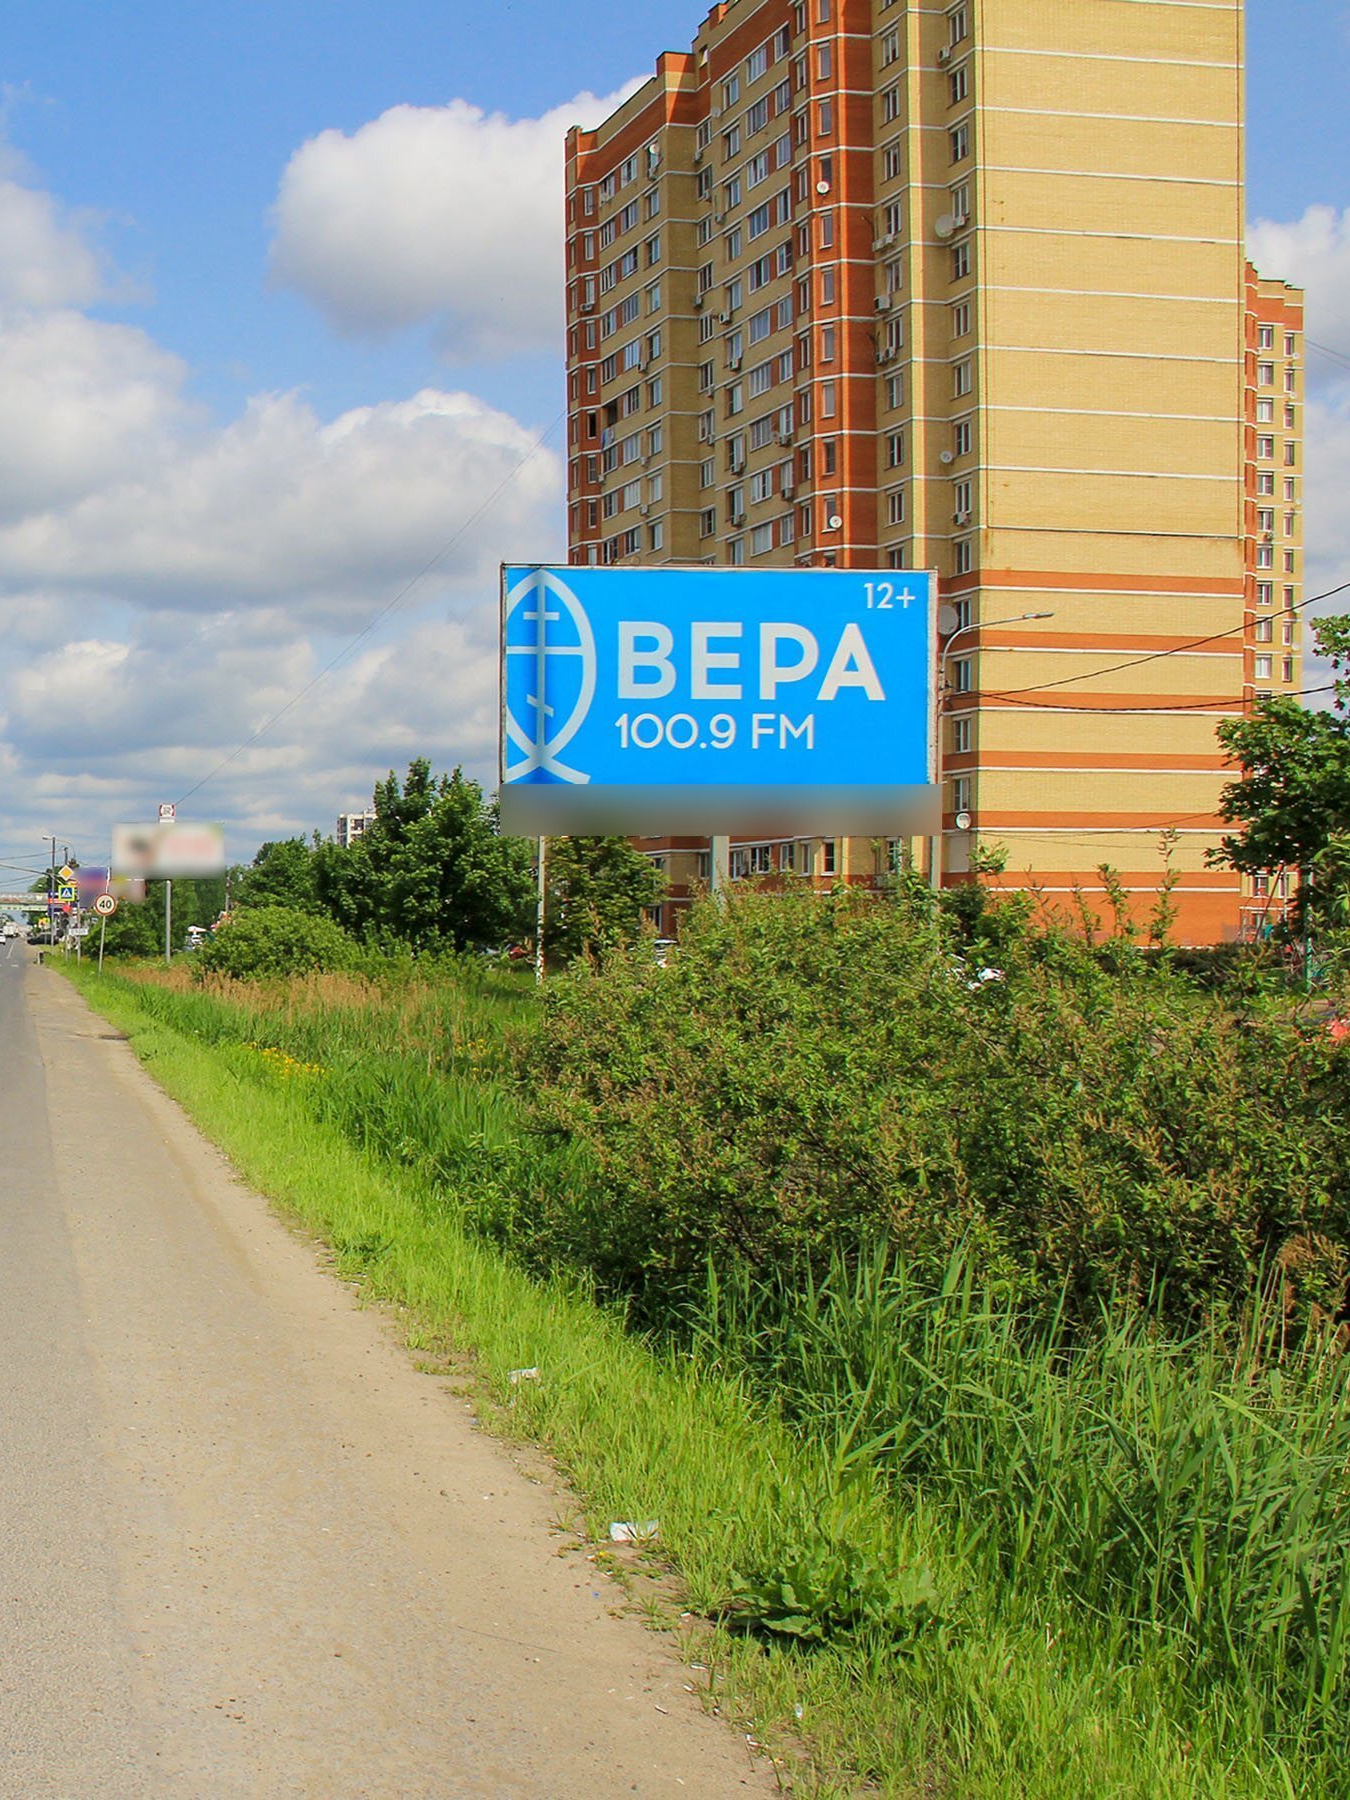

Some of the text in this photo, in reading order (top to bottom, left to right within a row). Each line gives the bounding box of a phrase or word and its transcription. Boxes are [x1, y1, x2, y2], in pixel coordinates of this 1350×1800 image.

[863, 583, 916, 609] 12+
[617, 621, 886, 701] ВЕРА
[615, 713, 815, 750] 100.9 FM
[99, 900, 112, 909] 40
